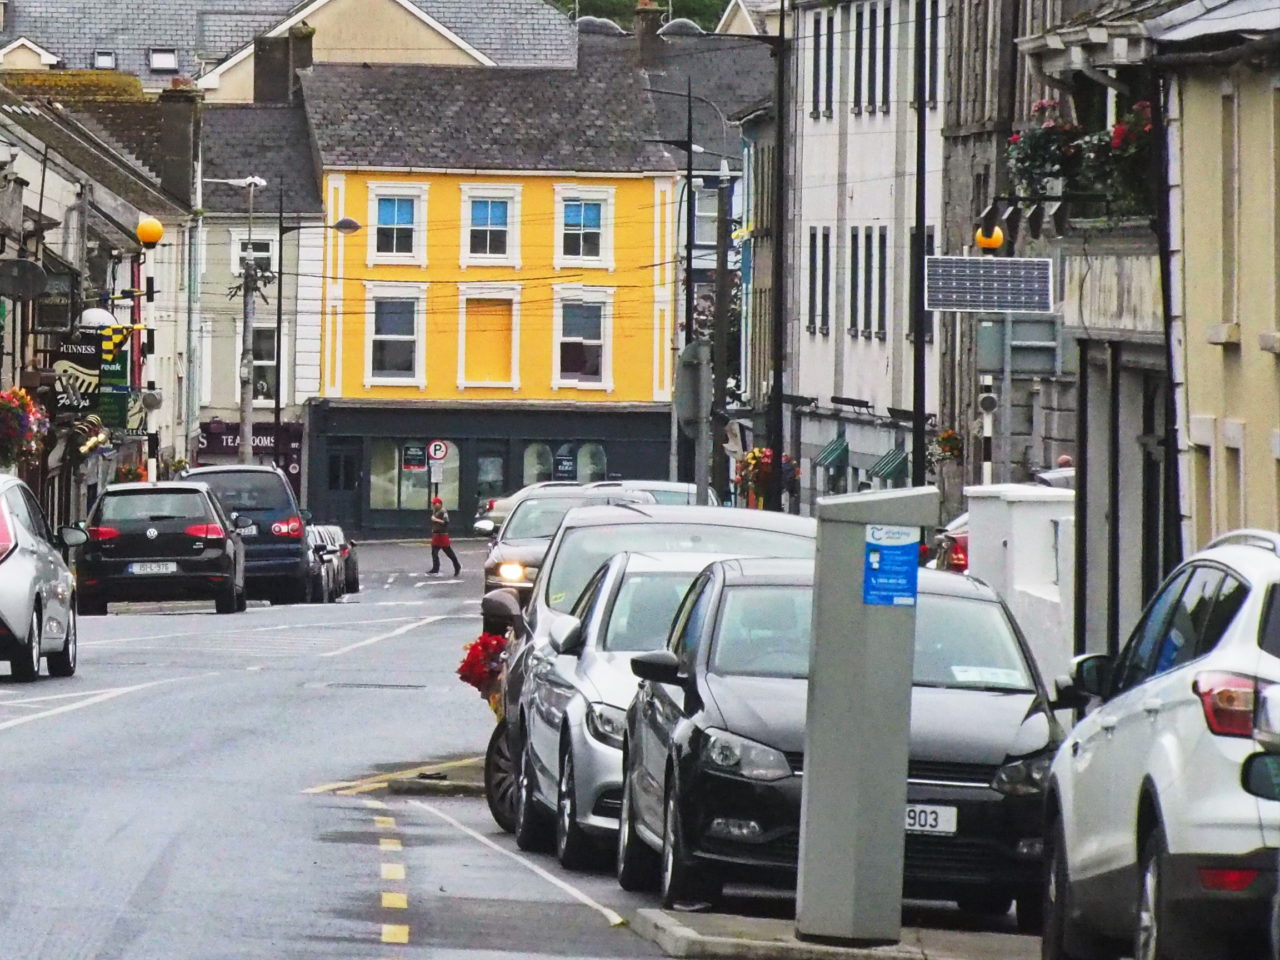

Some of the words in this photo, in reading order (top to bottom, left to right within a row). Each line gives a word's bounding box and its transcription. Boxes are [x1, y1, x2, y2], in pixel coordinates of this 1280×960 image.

[57, 394, 90, 409] Foey's
[222, 435, 240, 447] TEA
[252, 435, 275, 448] OOMS
[907, 808, 939, 829] 903
